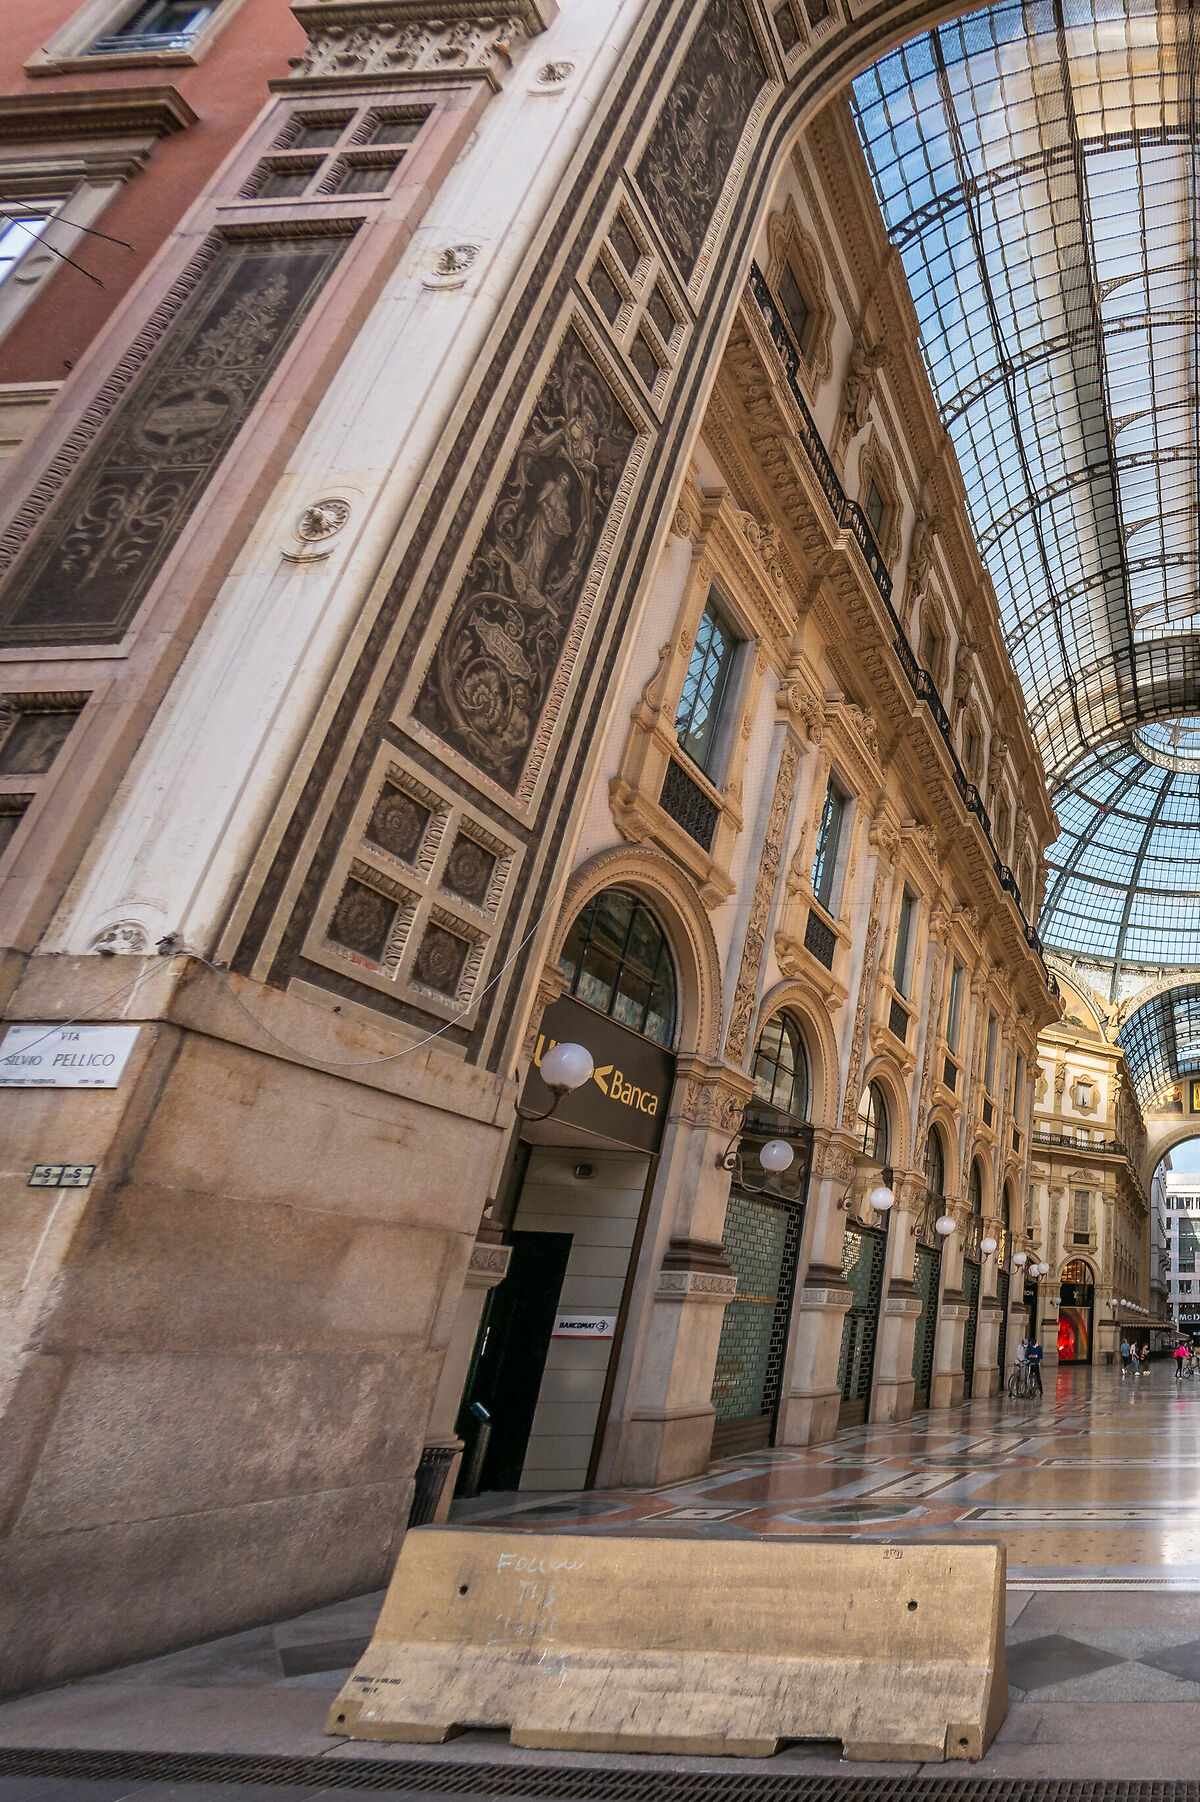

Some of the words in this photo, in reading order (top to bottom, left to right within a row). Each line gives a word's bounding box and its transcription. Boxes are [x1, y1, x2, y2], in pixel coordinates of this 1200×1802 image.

[60, 1032, 80, 1041] VIA
[3, 1055, 43, 1066] SILVIO
[52, 1053, 116, 1067] PELLICO
[609, 1069, 659, 1116] Banca
